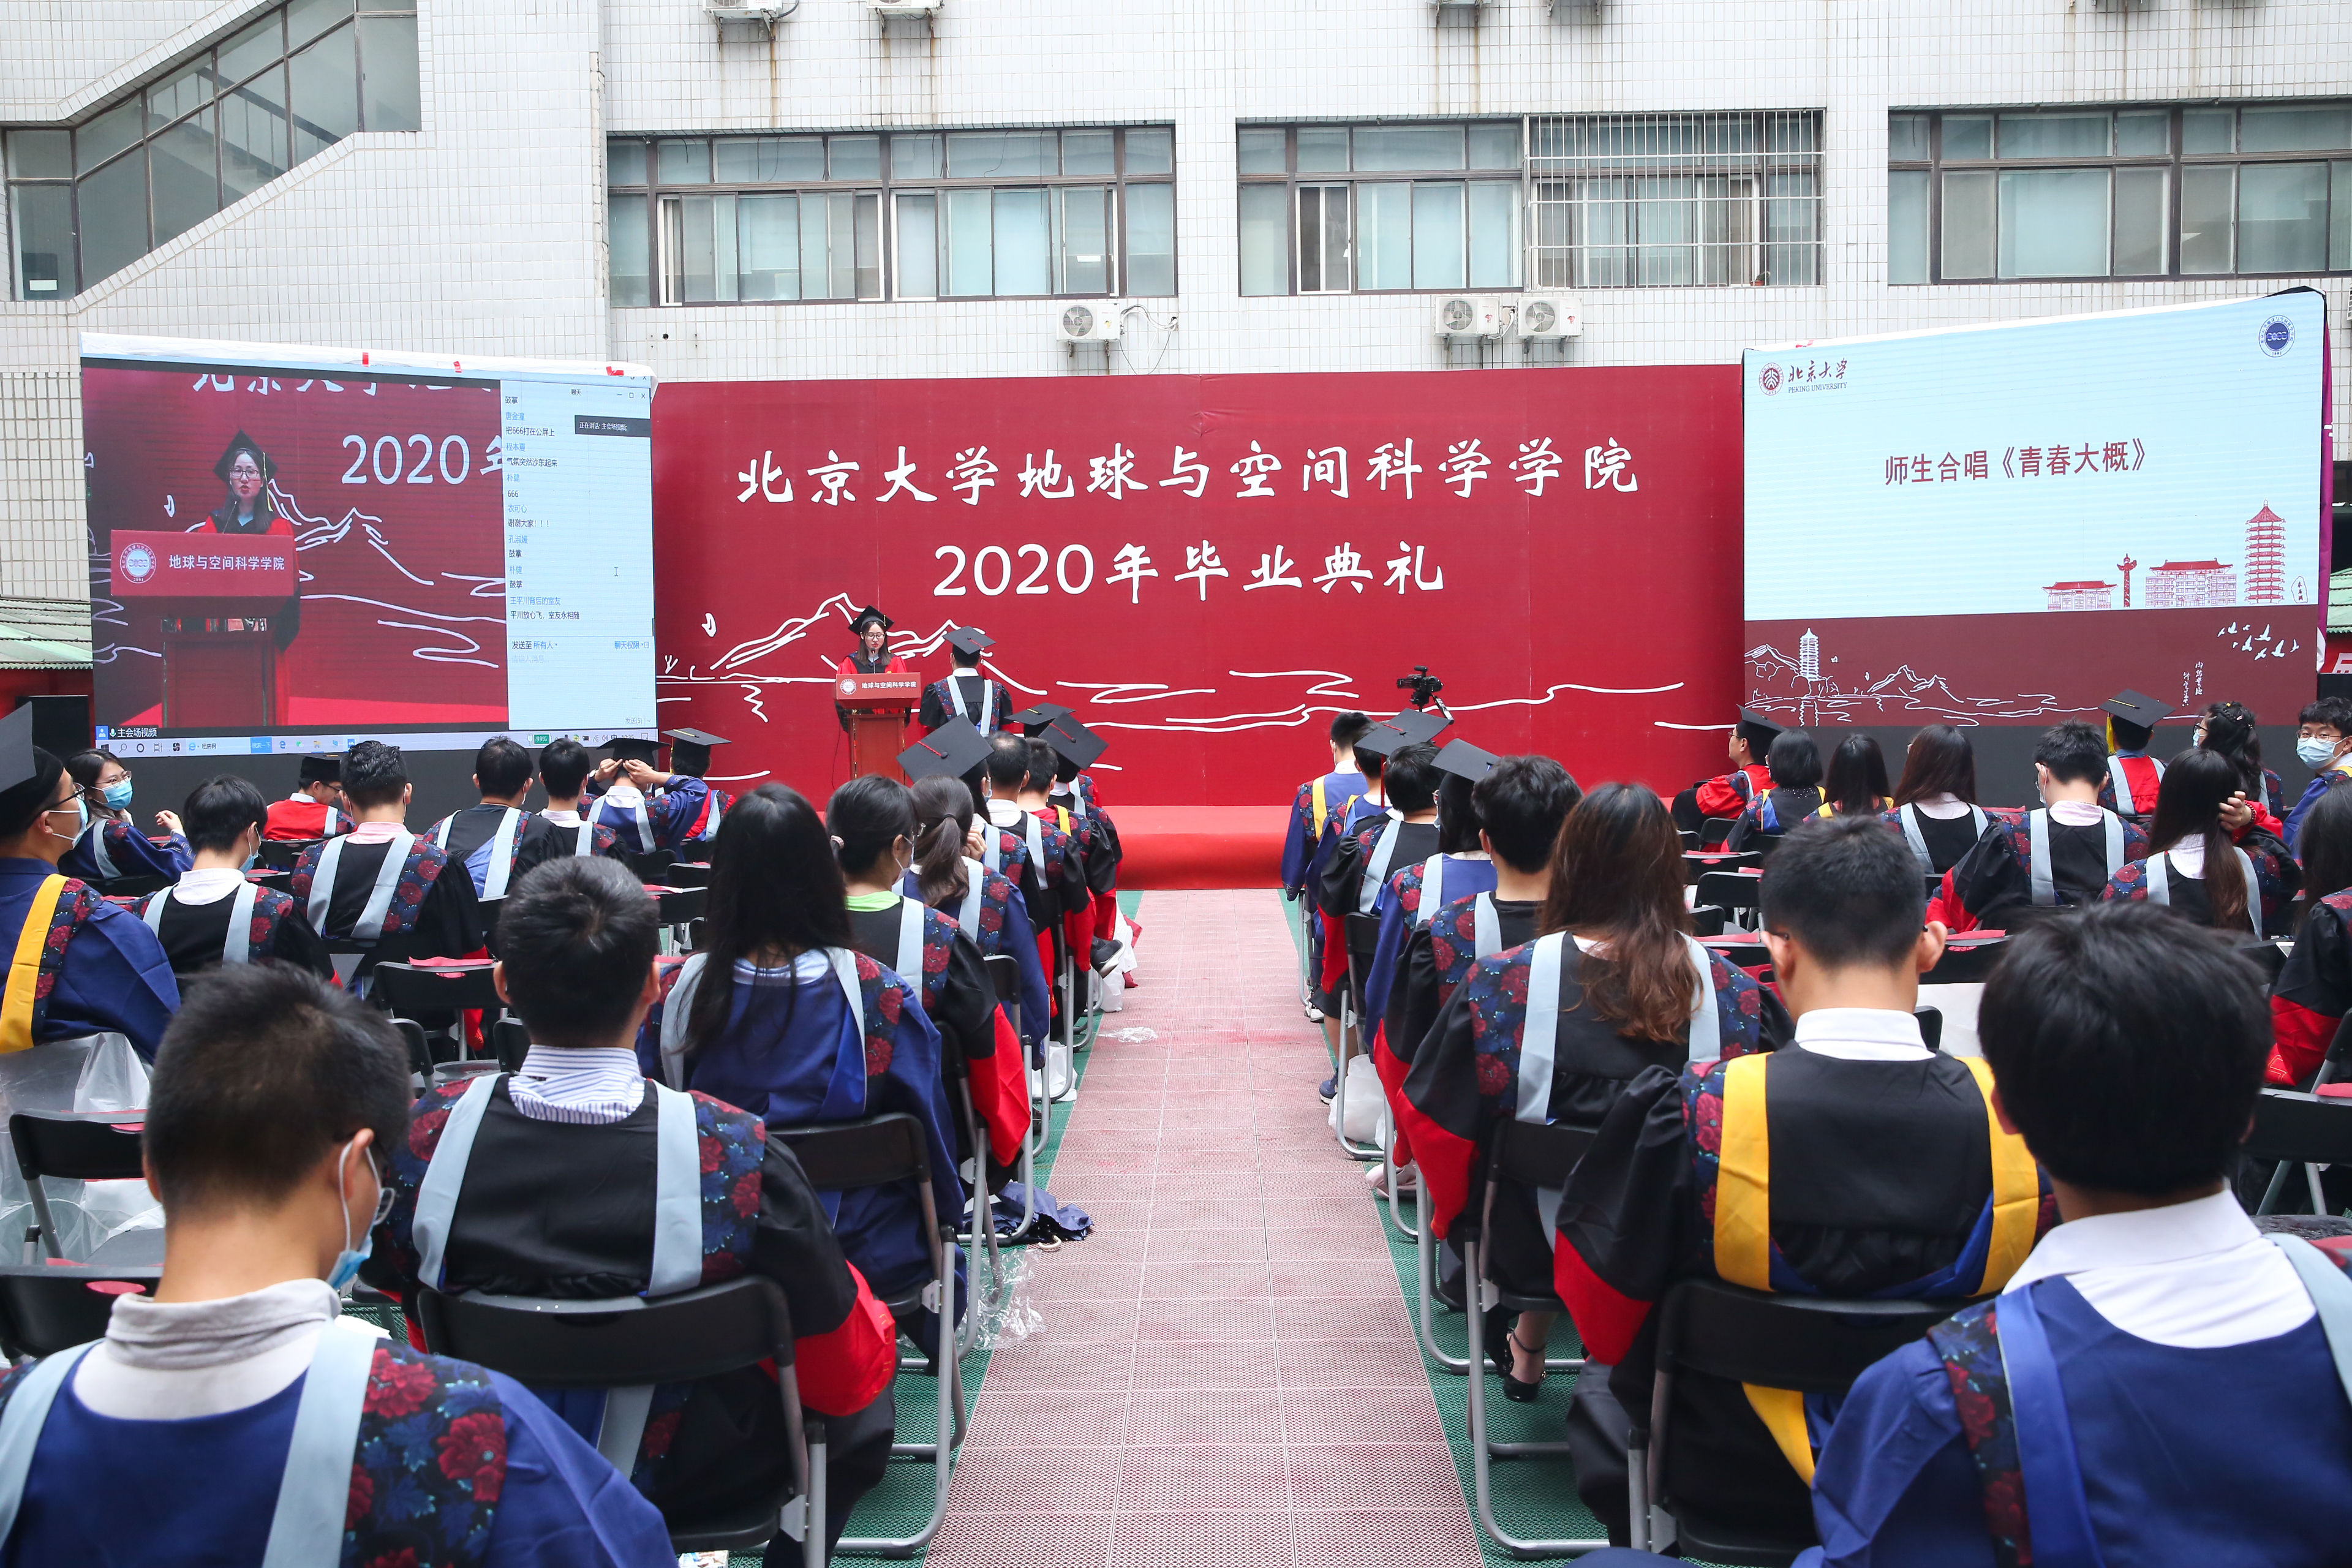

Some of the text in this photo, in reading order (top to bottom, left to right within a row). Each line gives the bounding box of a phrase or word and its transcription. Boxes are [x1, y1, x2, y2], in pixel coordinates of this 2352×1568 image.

[1788, 357, 1848, 383] 北京大学
[1811, 382, 1848, 391] UNIVERSITY
[505, 426, 556, 437] 把666打在公屏上
[507, 457, 558, 467] 气氛突然沙东起来
[1885, 437, 2146, 486] 师生合唱《青春大概》
[737, 437, 1638, 505] 北京大学地球与空间科学学院
[508, 549, 522, 558] 鼓掌
[168, 554, 285, 570] 地球与空间科学学院
[933, 540, 1444, 603] 2020年毕业典礼
[510, 580, 522, 589] 鼓掌
[510, 597, 561, 606] 王平川背后的室友
[511, 641, 554, 649] 发送至 所有人
[614, 641, 640, 649] 聊天权限
[118, 728, 157, 737] 主会场视频
